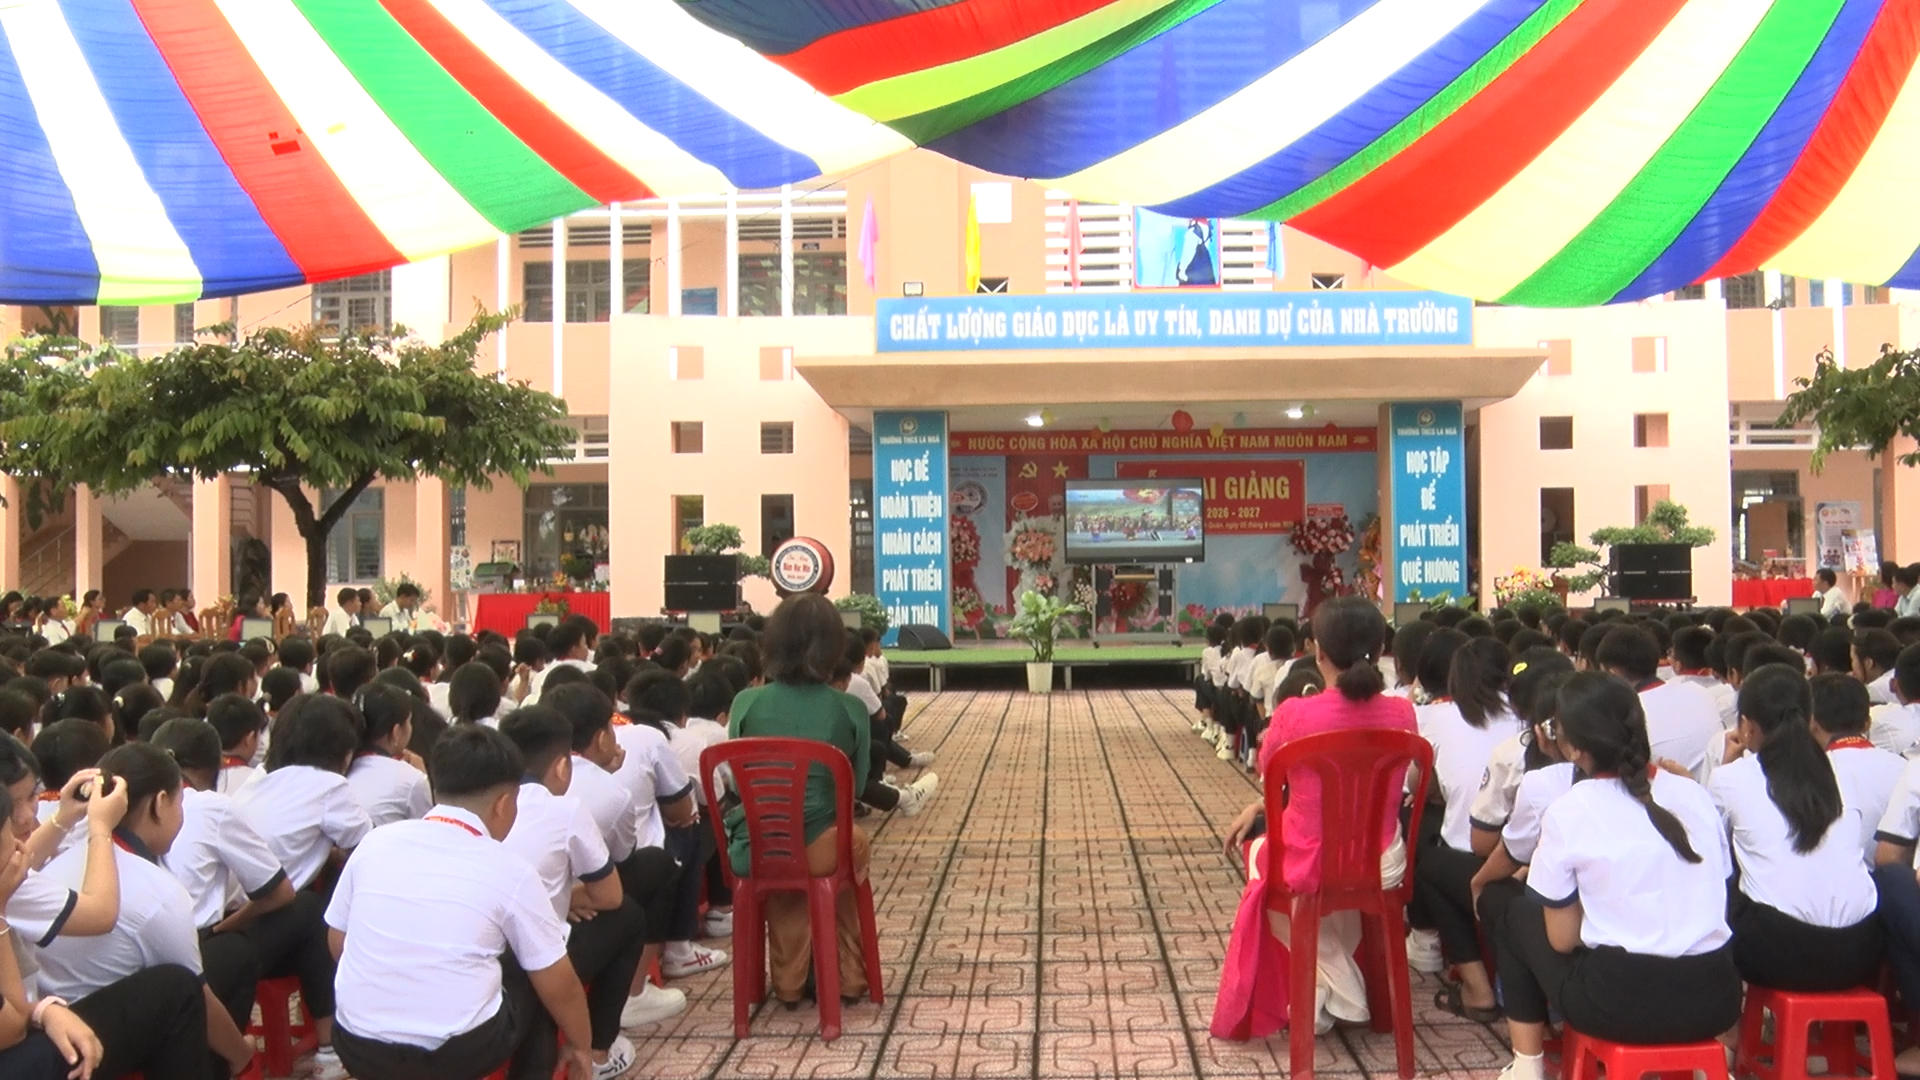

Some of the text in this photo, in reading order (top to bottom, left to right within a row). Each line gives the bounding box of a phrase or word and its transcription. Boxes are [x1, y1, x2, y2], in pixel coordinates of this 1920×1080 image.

[890, 300, 1458, 345] CHẤT LƯỢNG GIÁO DỤC LÀ UY TÍN, DANH DỰ CỦA NHÀ TRƯỜNG
[968, 434, 1005, 450] NƯỚC
[1009, 434, 1046, 452] CỘNG
[1102, 434, 1125, 452] HỘI
[1130, 433, 1158, 450] CHỦ
[1162, 433, 1202, 449] NGHĨA
[1206, 433, 1236, 451] VIỆT
[1240, 435, 1270, 449] NAM
[891, 450, 929, 487] HỌC ĐỂ
[1406, 446, 1450, 478] HỌC TẬP
[1224, 470, 1290, 499] GIẢNG
[1421, 478, 1436, 510] ĐỂ
[880, 490, 942, 523] HOÀN THIỆN
[1207, 507, 1229, 518] 2026
[1238, 507, 1260, 518] 2027
[882, 527, 942, 555] NHÂN CÁCH
[1400, 514, 1459, 547] PHÁT TRIỂN
[882, 560, 942, 592] PHÁT TRIỂN
[1401, 556, 1459, 586] QUÊ HƯƠNG
[911, 600, 938, 628] THÂN
